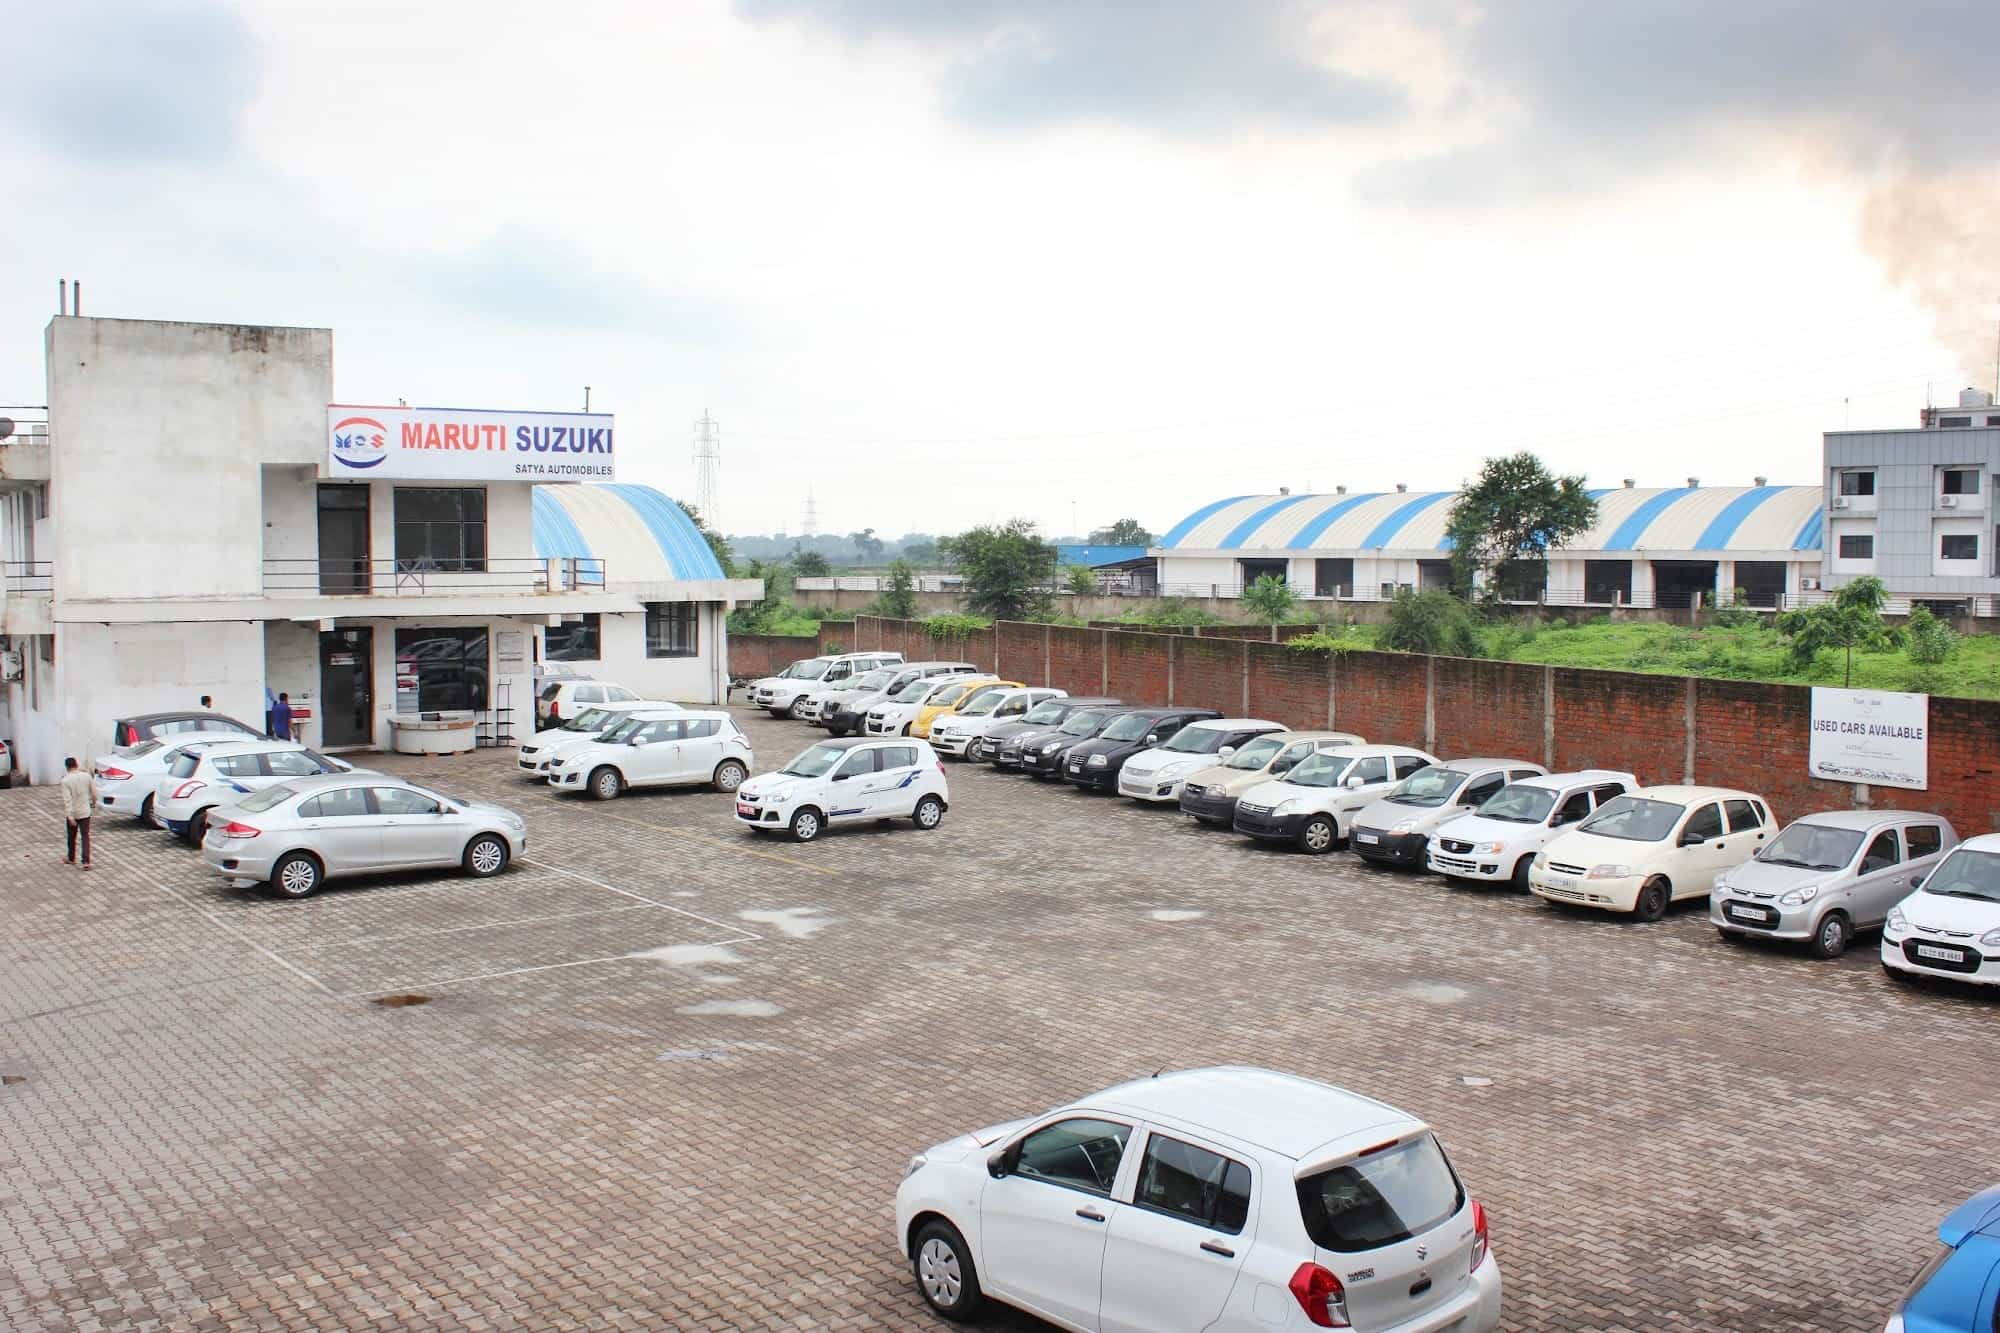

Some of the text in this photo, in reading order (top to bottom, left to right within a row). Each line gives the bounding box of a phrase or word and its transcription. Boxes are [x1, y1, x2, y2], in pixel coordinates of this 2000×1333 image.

[401, 422, 613, 453] MARUTI SUZUKI
[515, 464, 613, 475] SATYA AUTOMOBILES
[1813, 720, 1923, 740] USED CARS AVAILABLE
